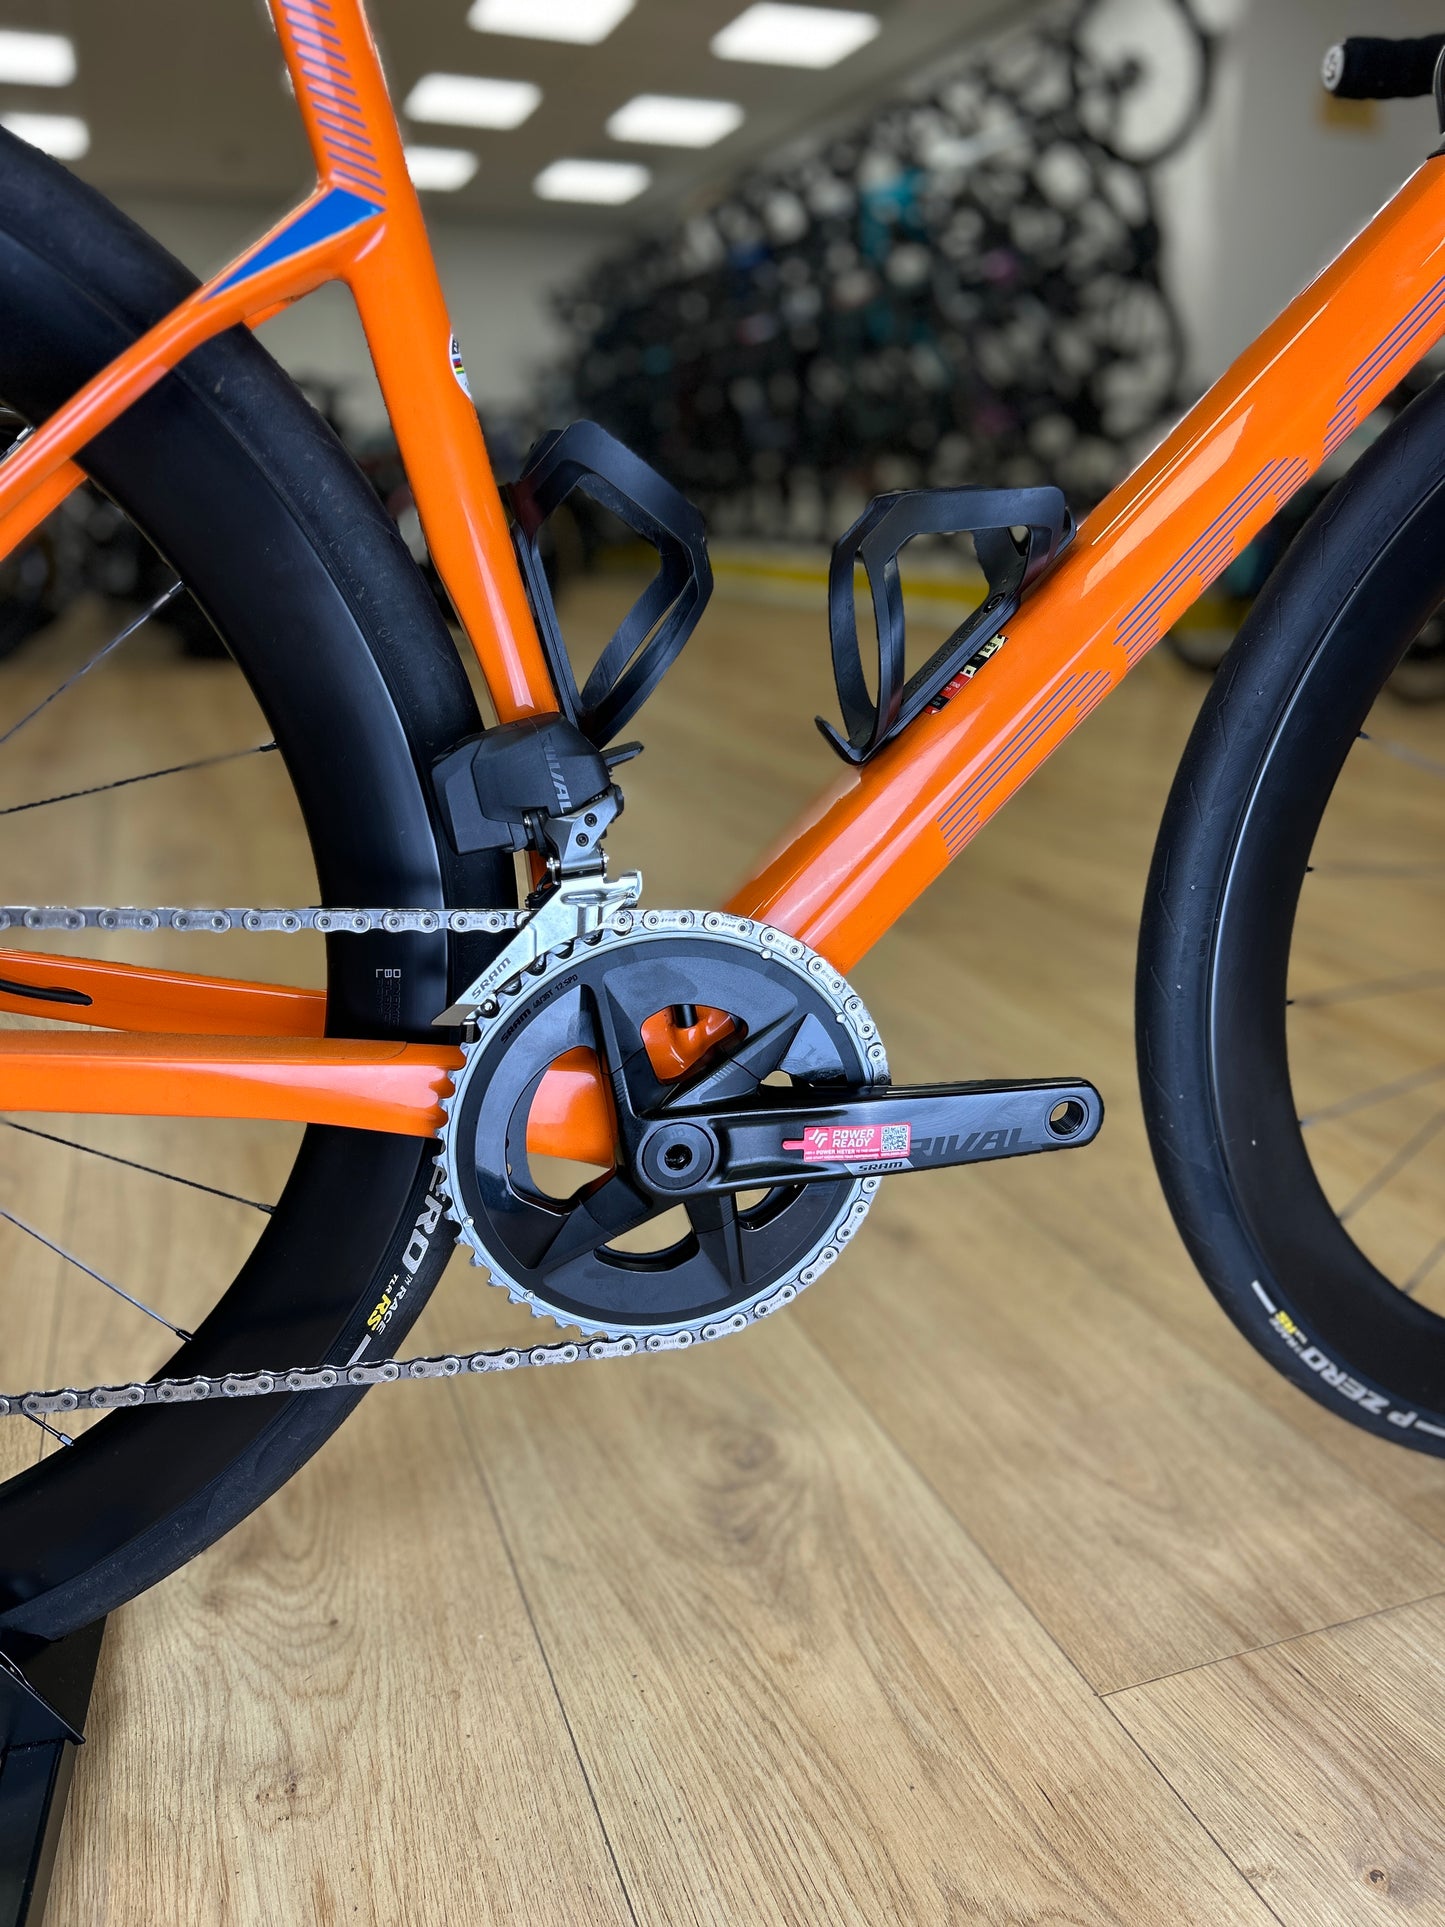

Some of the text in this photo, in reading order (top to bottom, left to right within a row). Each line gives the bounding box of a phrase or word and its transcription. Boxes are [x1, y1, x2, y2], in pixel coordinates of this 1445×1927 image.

[471, 957, 512, 1000] SRAM
[500, 1008, 532, 1044] SRAM
[832, 1128, 875, 1139] POWER
[832, 1138, 872, 1148] READY
[858, 1161, 903, 1172] SRAM
[367, 1273, 399, 1331] TLR RS
[376, 1285, 407, 1335] RACE
[1300, 1346, 1390, 1414] ZERO
[1387, 1411, 1418, 1428] P
